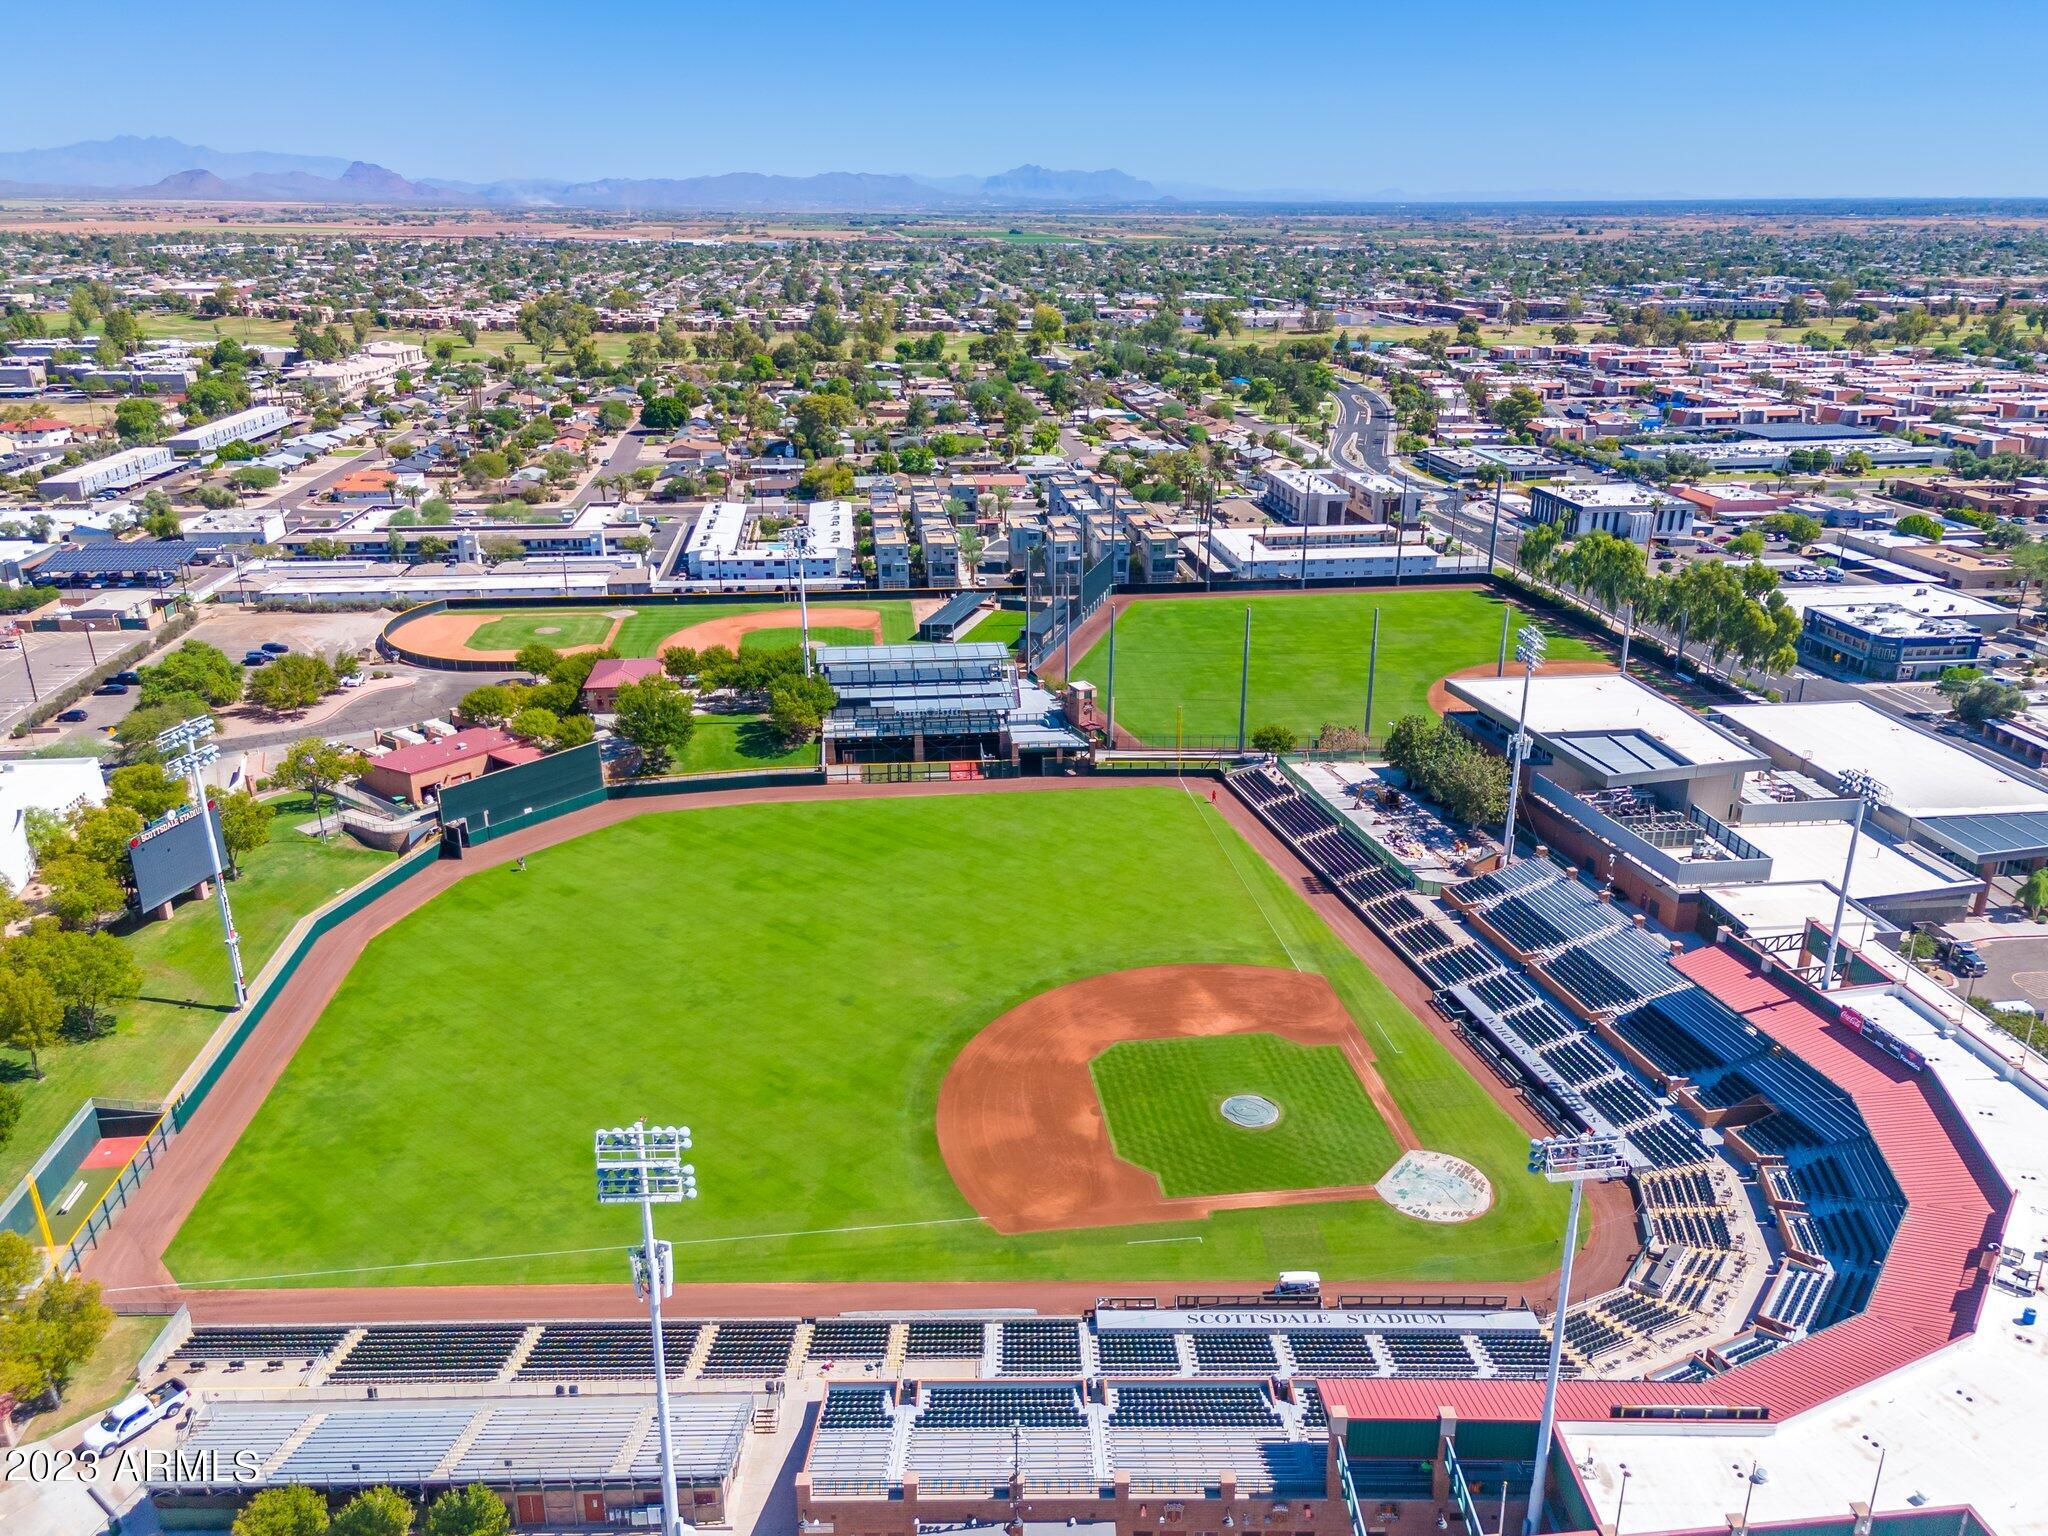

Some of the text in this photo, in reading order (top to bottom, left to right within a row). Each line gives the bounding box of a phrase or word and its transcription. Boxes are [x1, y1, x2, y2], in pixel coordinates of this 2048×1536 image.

[141, 818, 180, 842] SCOTTSDALE
[1484, 1016, 1597, 1124] SCOTDALE STADIUM
[1186, 1313, 1447, 1324] SCOTTSDALE STADIUM
